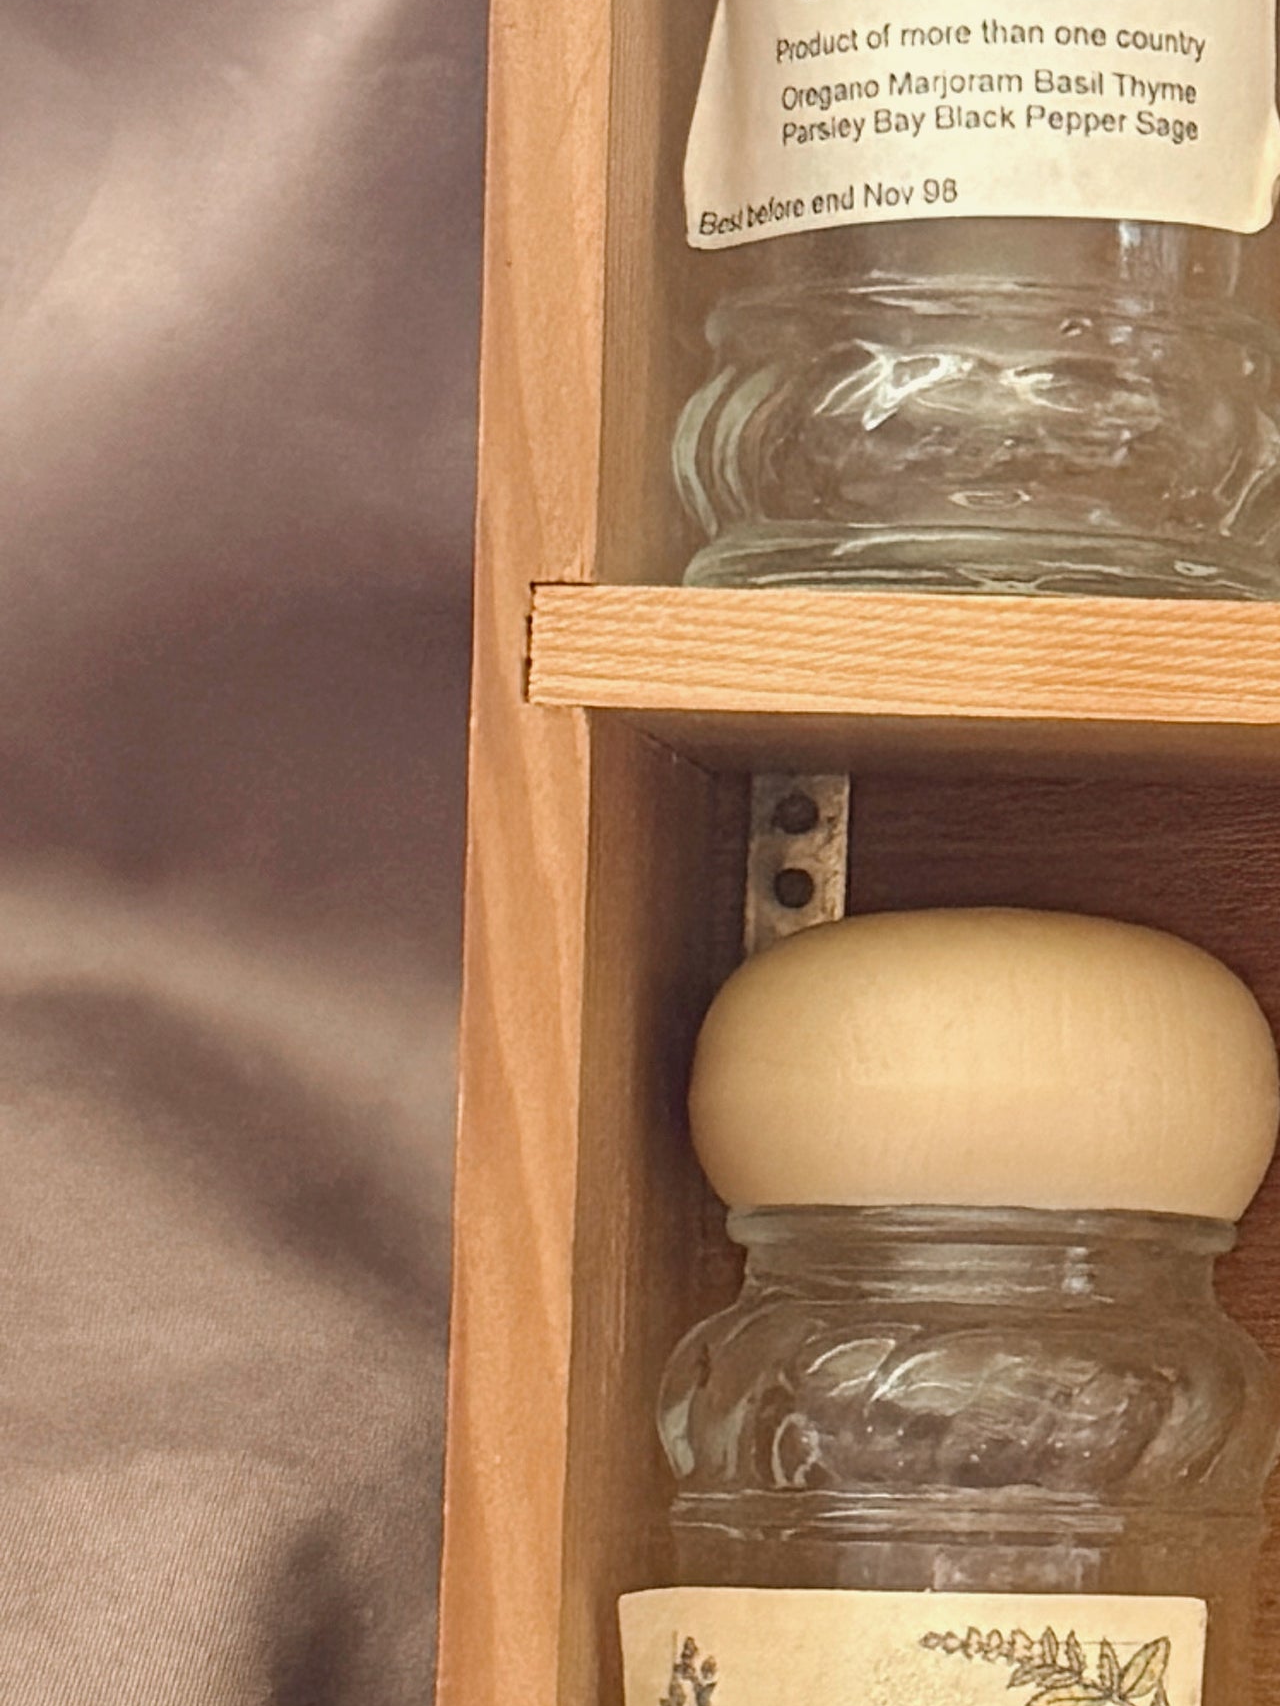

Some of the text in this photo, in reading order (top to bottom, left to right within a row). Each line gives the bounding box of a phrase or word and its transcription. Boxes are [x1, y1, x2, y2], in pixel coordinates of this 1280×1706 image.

[776, 19, 1206, 64] Product of more than one country
[782, 68, 1197, 111] Oregano Marjoram Basil Thyme
[782, 104, 1199, 147] Parsley Bay Black Pepper Sage
[699, 177, 958, 235] Best before end Nov 98
